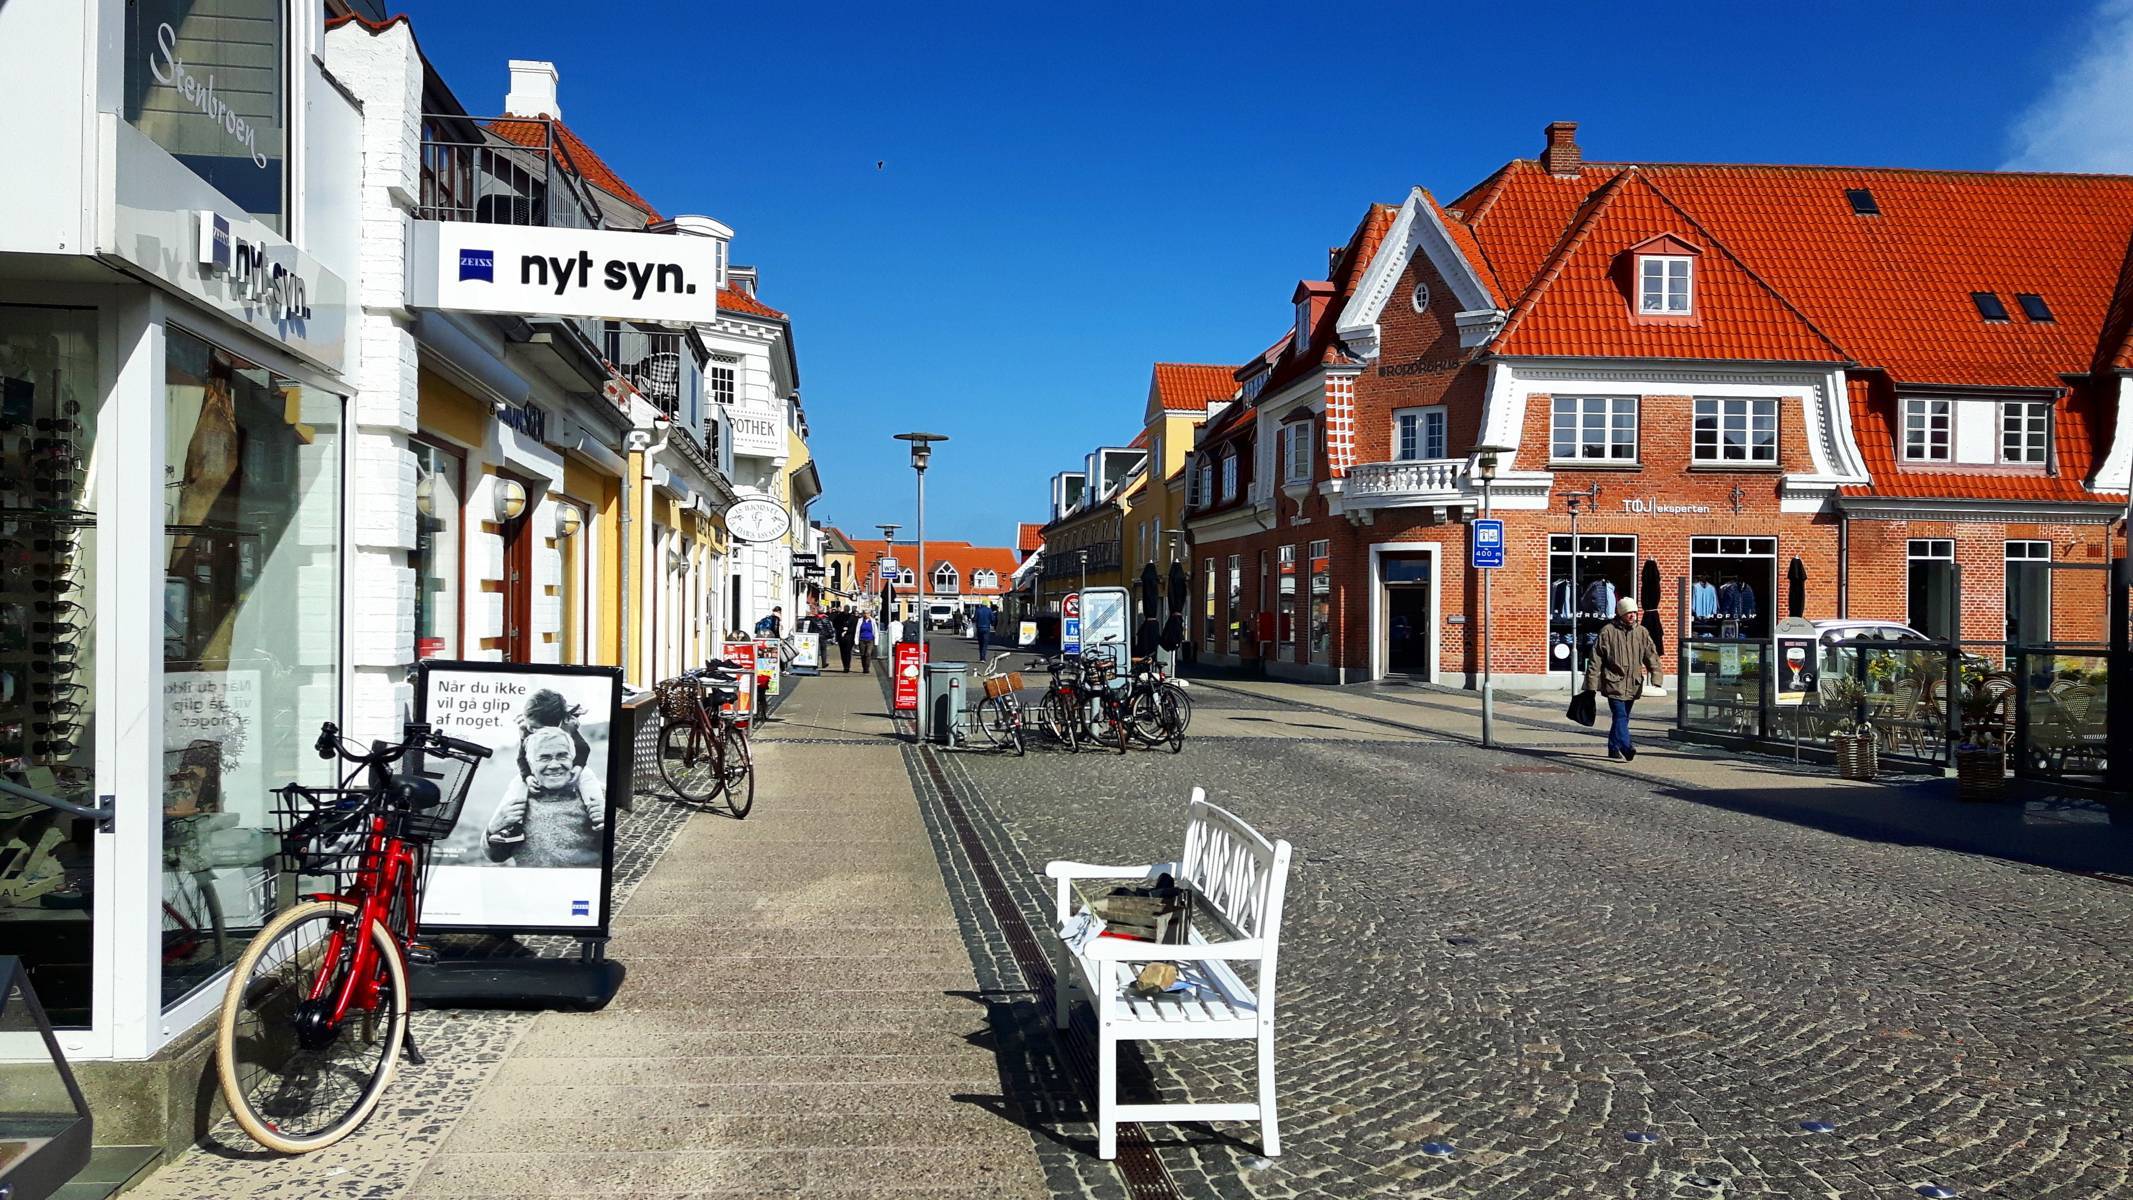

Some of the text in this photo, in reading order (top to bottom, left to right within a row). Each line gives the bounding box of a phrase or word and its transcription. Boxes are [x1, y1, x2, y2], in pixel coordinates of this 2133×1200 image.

[150, 22, 267, 169] Stenbroen
[213, 227, 230, 247] ZEISS
[460, 257, 493, 268] ZEISS
[521, 250, 697, 301] nyt syn.
[731, 417, 775, 436] POTHEK
[1622, 498, 1710, 515] TØJ eksperten
[437, 680, 527, 695] Når du ikke
[437, 697, 511, 714] vil gå glip
[435, 713, 504, 729] af noget.
